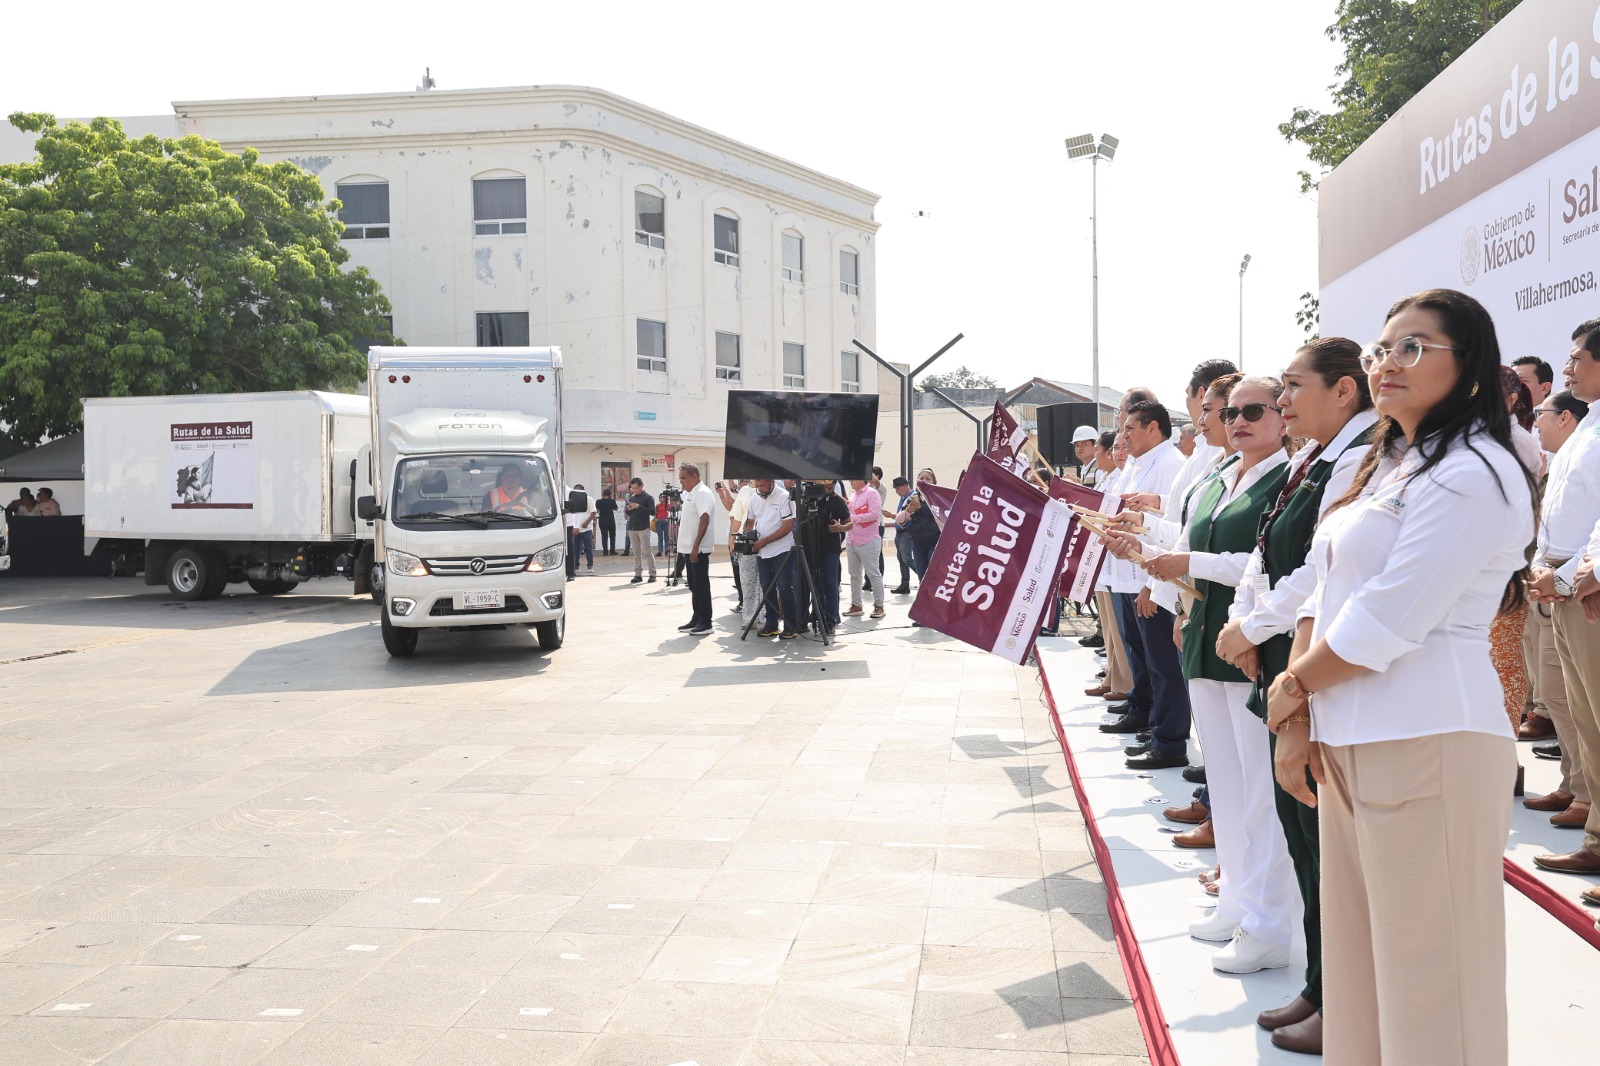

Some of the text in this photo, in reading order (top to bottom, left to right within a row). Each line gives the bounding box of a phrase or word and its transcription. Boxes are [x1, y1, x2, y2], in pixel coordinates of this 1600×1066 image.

[1419, 104, 1493, 195] Rutas
[1500, 64, 1538, 140] de
[1546, 35, 1580, 112] la
[1563, 165, 1600, 224] Sal
[1484, 202, 1536, 241] Gobierno de
[1592, 222, 1600, 233] de
[1484, 230, 1535, 273] México
[1515, 271, 1597, 312] Villahermosa,
[173, 425, 251, 436] Rutas de la Salud
[972, 485, 994, 506] la
[962, 510, 983, 535] de
[934, 541, 971, 603] Rutas
[961, 497, 1026, 611] Salud
[1022, 578, 1038, 603] Salud
[1013, 613, 1027, 638] México
